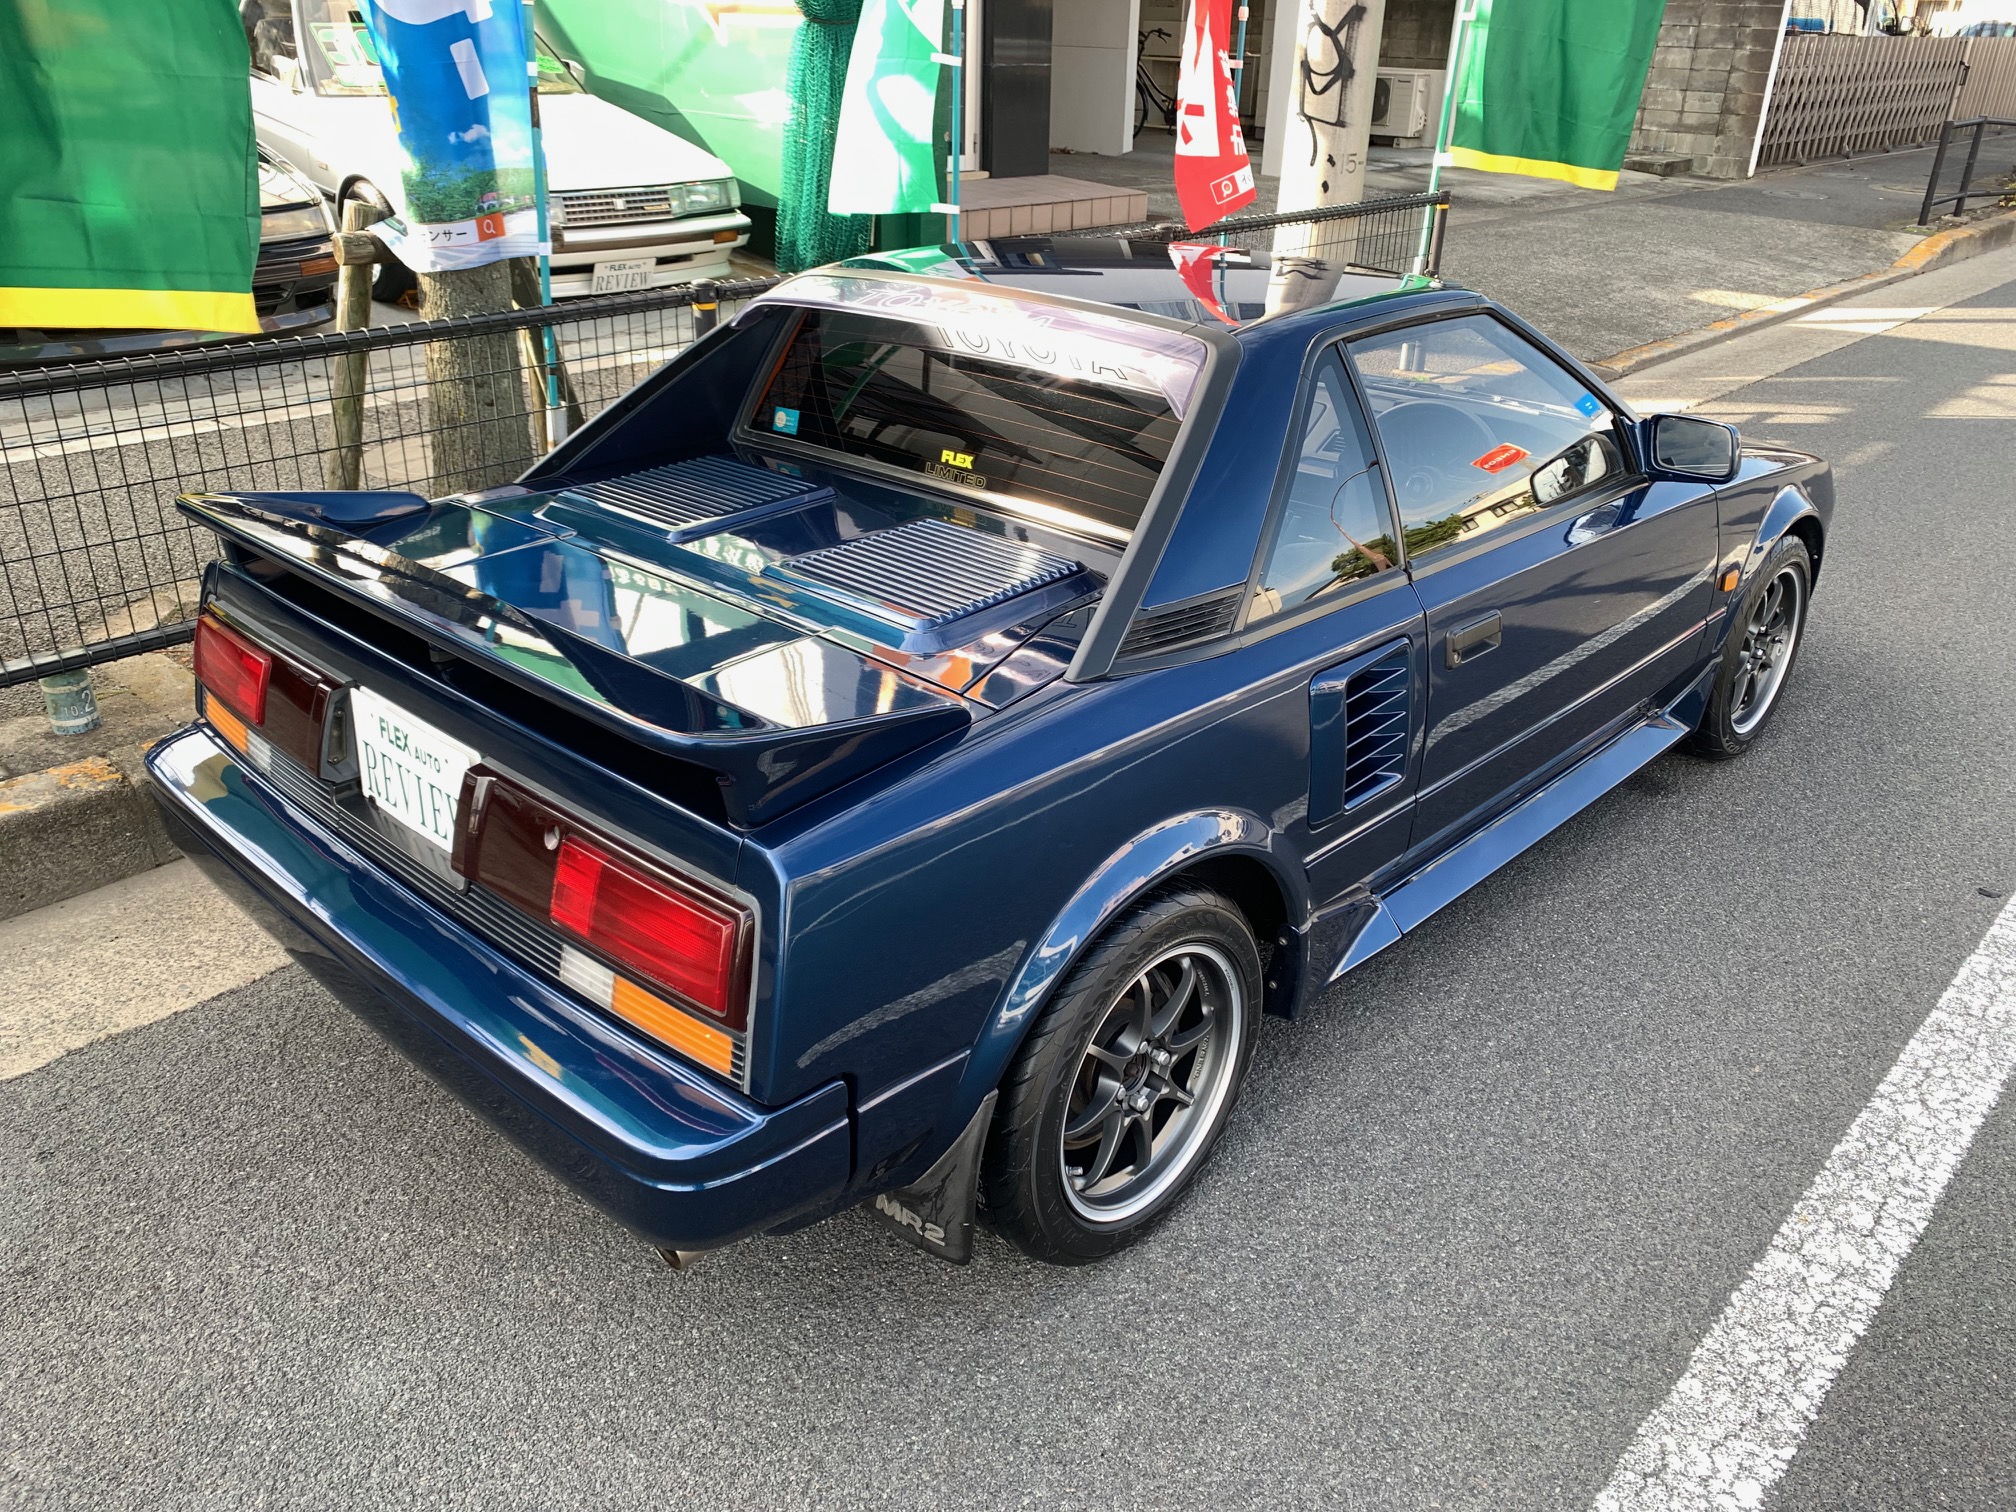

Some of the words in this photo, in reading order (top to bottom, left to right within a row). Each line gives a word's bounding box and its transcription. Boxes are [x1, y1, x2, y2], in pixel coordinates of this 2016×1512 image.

[421, 229, 467, 242] ンサー
[595, 271, 652, 292] REVIEW
[940, 449, 974, 469] FLEX
[925, 461, 986, 489] LIMITED
[378, 716, 412, 757] FLEX
[414, 746, 441, 774] AUTO
[875, 1193, 946, 1247] MR2
